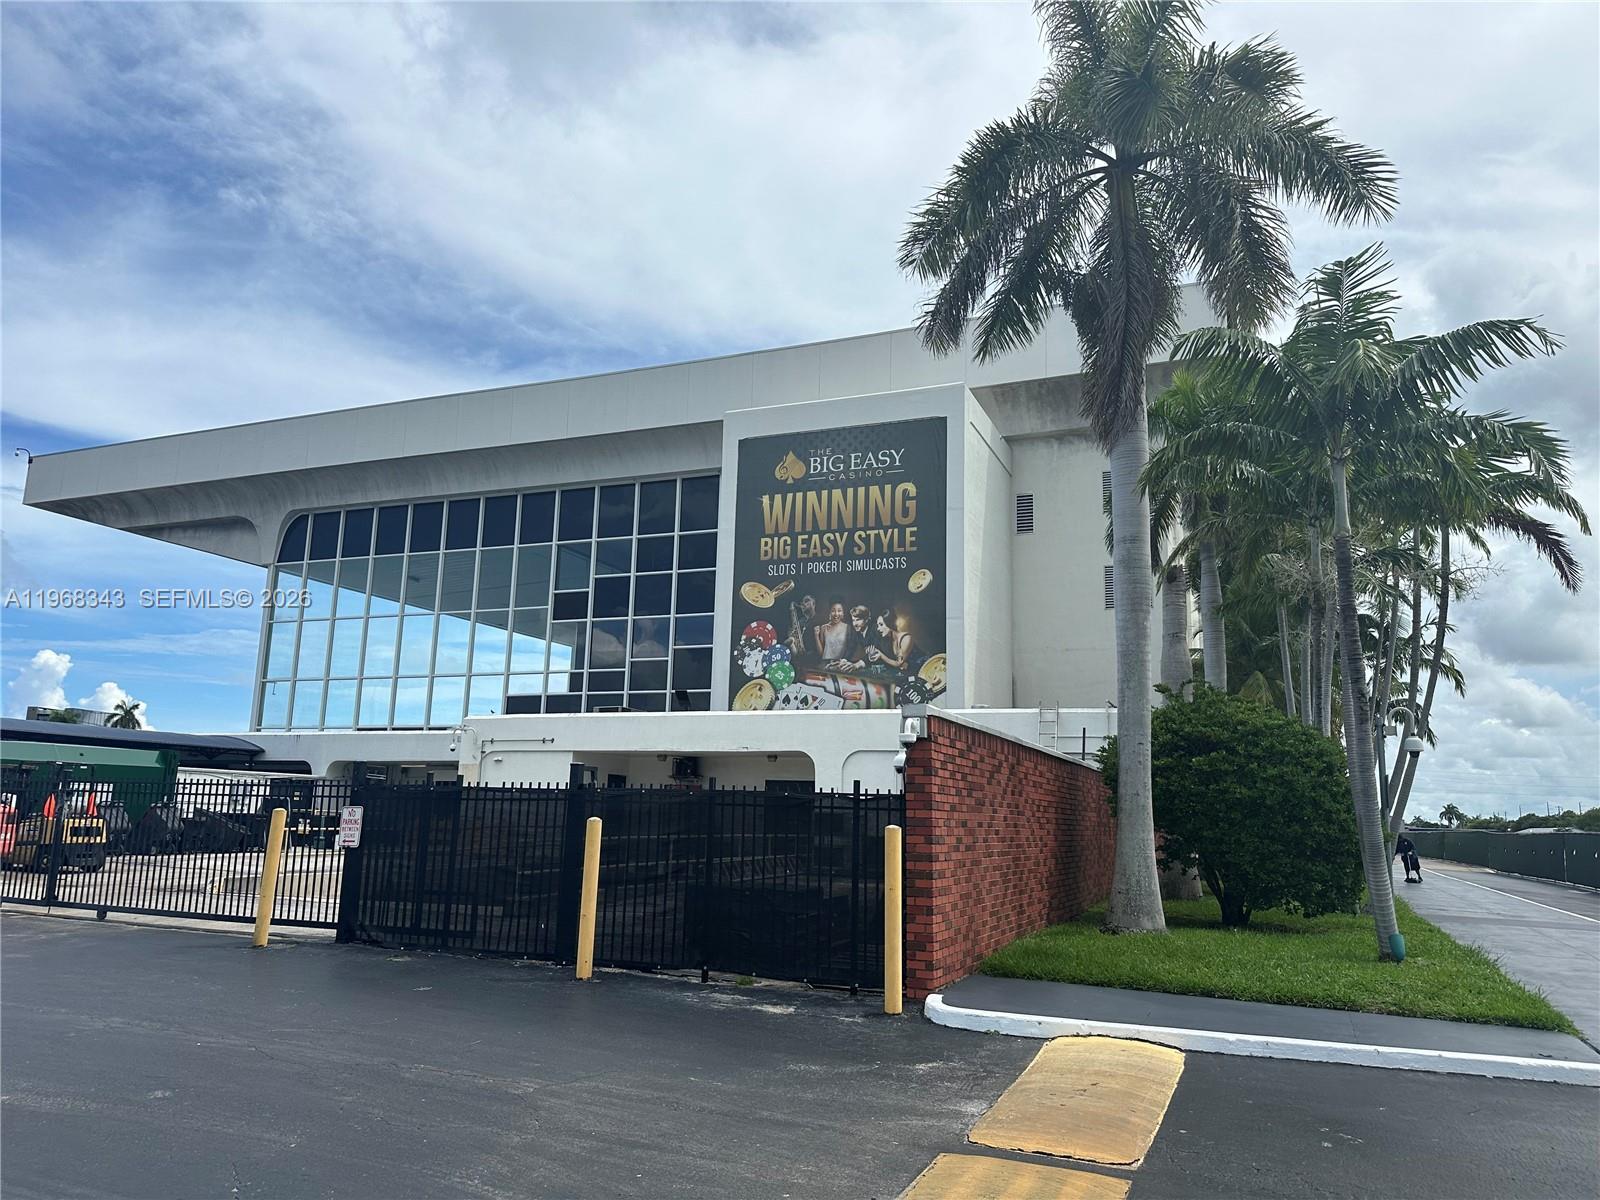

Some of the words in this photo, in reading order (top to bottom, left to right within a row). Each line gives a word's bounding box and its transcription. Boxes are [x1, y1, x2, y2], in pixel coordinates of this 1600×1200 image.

[808, 447, 832, 456] THE
[809, 455, 844, 473] BIG
[849, 448, 905, 470] EASY
[828, 469, 883, 480] CASINO
[761, 482, 917, 535] WINNING
[760, 536, 792, 561] BIG
[797, 532, 848, 558] EASY
[853, 527, 918, 555] STYLE
[768, 563, 796, 576] SLOTS
[807, 561, 837, 574] POKER
[846, 556, 907, 572] SIMULCASTS
[771, 653, 781, 661] 50
[905, 689, 922, 704] 100
[348, 809, 356, 817] NO
